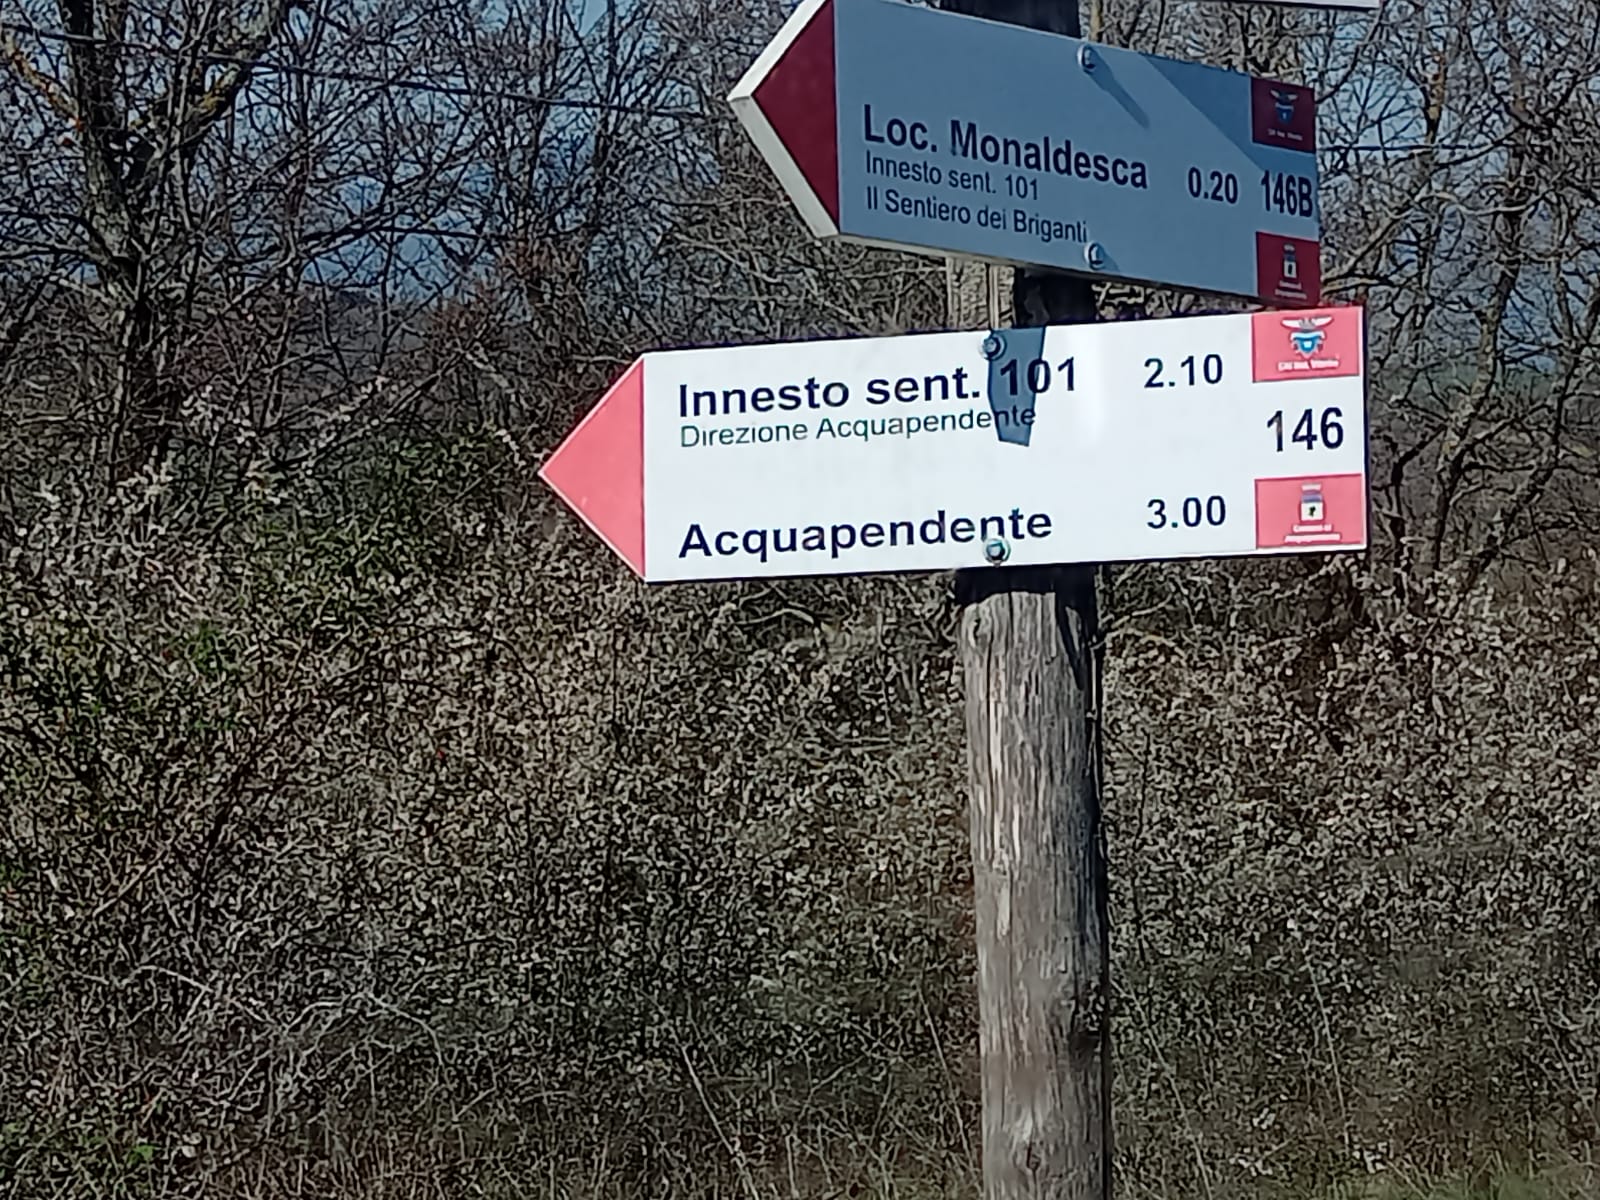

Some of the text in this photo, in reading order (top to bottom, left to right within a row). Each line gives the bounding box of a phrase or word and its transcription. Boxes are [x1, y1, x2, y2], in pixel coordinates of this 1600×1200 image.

[864, 104, 1149, 190] Loc. Monaldesca
[866, 150, 1040, 201] Innesto sent. 101
[1188, 166, 1239, 204] 0.20
[1261, 169, 1313, 218] 146B
[885, 188, 971, 225] Sentiero
[977, 205, 1007, 231] dei
[1014, 209, 1088, 243] Briganti
[679, 356, 1077, 417] Innesto sent. 101
[1143, 353, 1224, 389] 2.10
[681, 406, 1036, 448] Direzione Acquapendente
[1266, 406, 1345, 452] 146
[678, 508, 1053, 562] Acquapendente
[1147, 495, 1227, 529] 3.00
